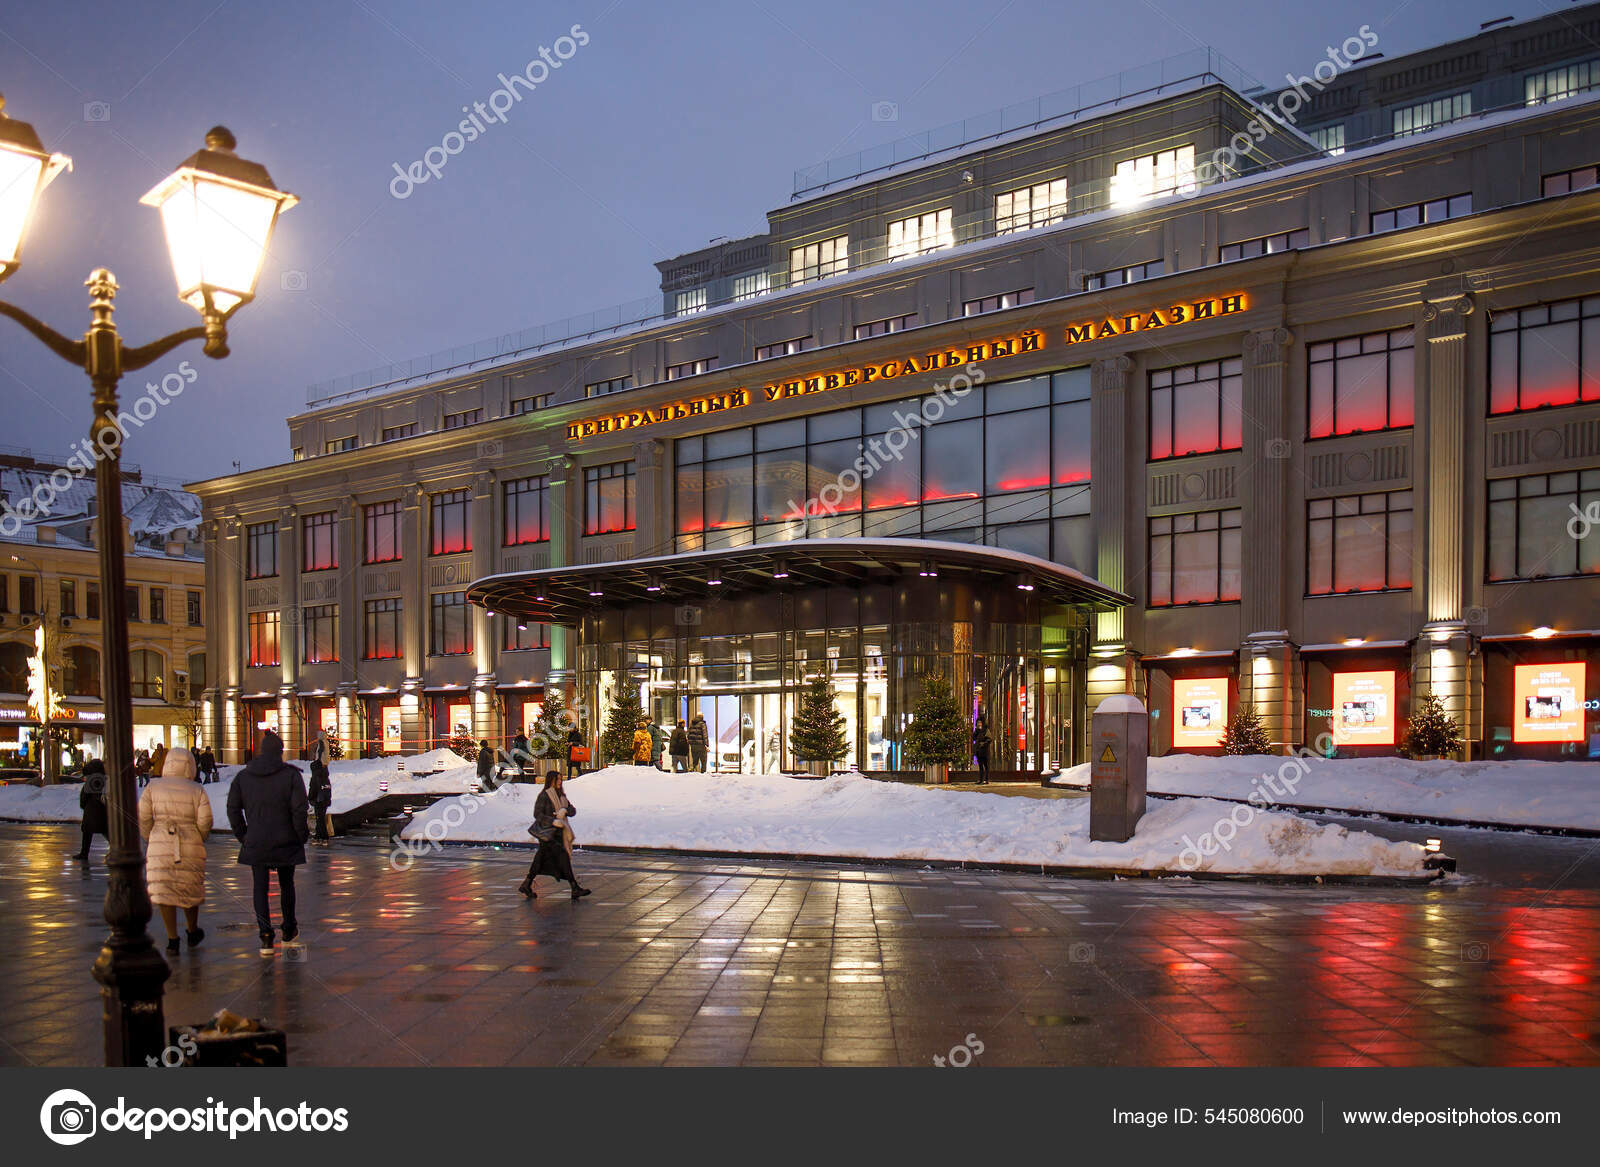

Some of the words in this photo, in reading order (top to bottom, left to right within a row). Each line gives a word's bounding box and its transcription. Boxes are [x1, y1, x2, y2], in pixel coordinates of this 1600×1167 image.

[567, 389, 747, 440] ЦЕНТРАЛЬНЫЙ
[764, 330, 1042, 400] УНИВЕРСАЛЬНЫЙ
[1065, 293, 1246, 344] МАГАЗИН
